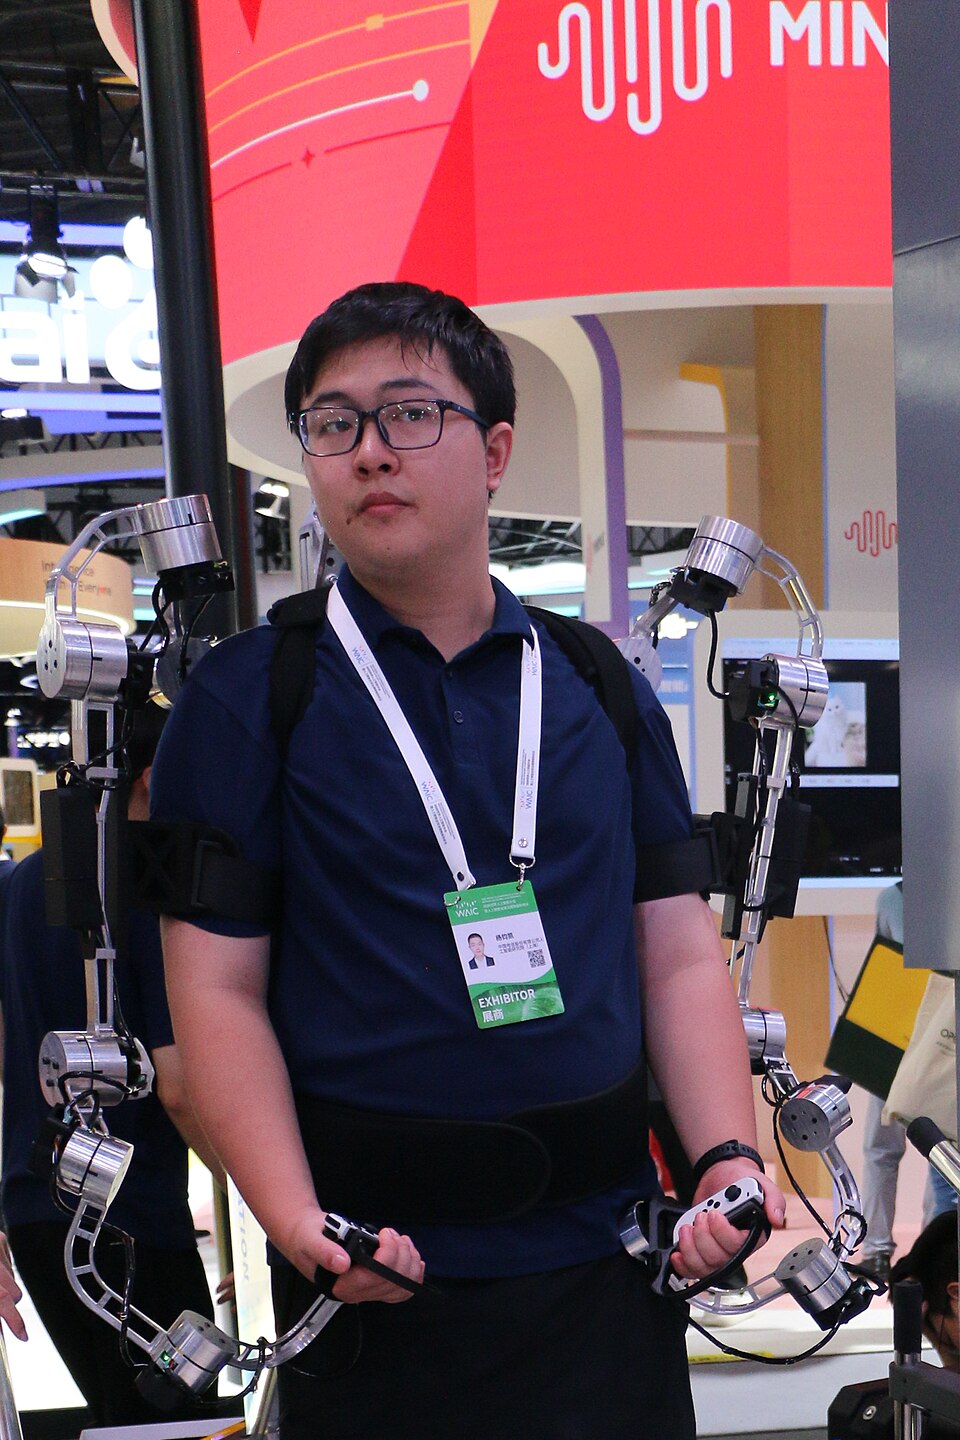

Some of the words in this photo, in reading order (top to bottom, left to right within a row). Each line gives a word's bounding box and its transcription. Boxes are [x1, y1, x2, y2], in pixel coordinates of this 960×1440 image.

[769, 0, 889, 66] MIN
[456, 907, 480, 918] WAIC
[478, 988, 536, 1009] EXHIBITOR
[482, 1008, 505, 1023] 展商
